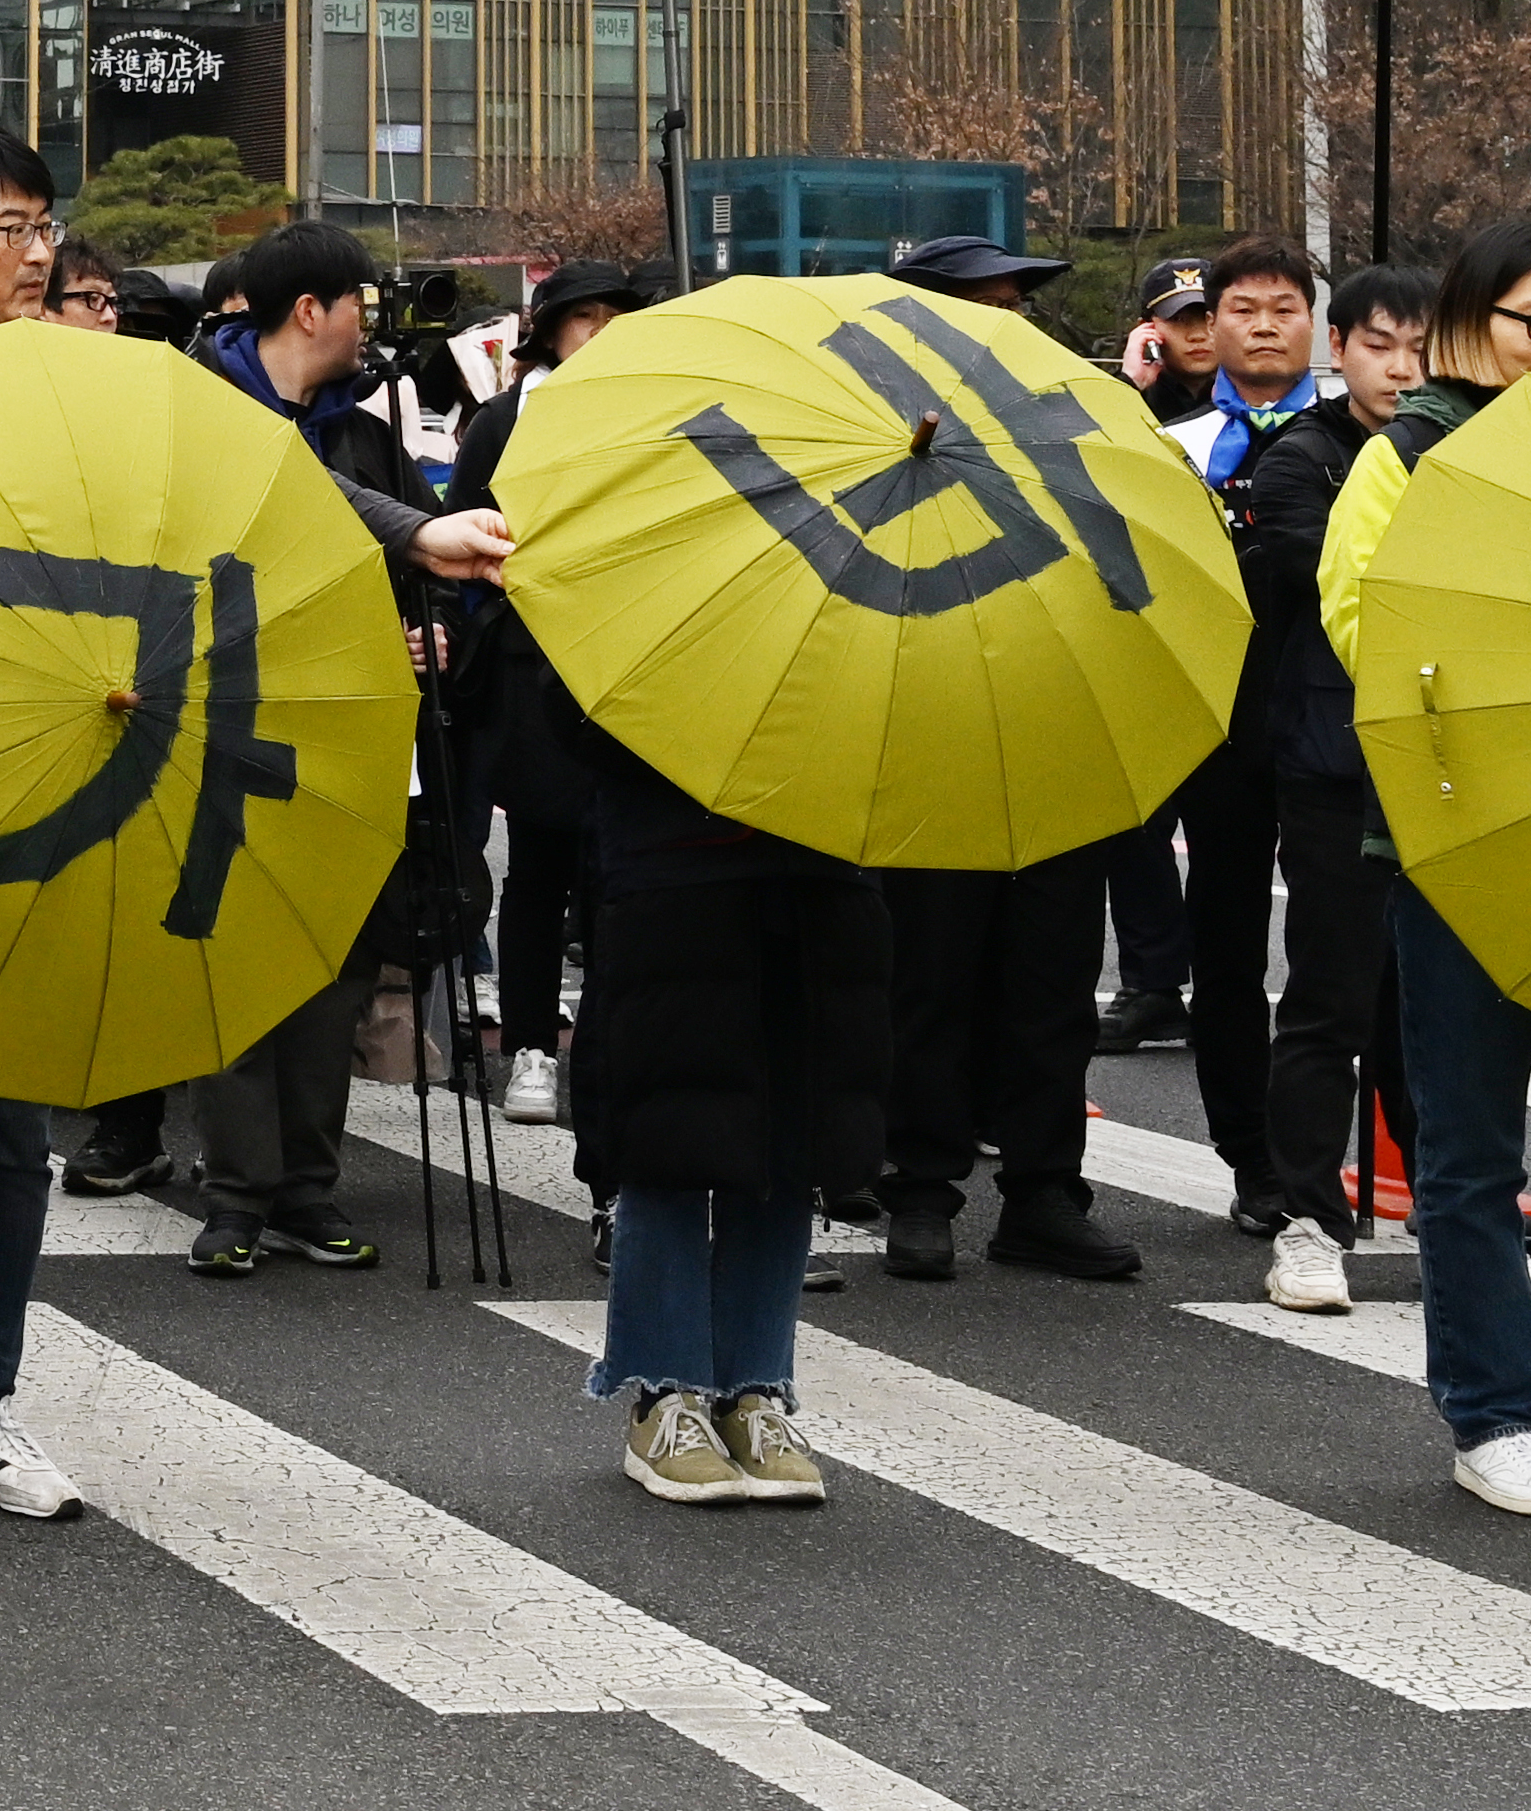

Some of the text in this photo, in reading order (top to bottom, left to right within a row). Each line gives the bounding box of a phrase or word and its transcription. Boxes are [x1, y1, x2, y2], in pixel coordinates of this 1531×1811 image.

[324, 4, 472, 33] 하나 여성 의원
[109, 28, 202, 51] GRAN SEOUL MALL
